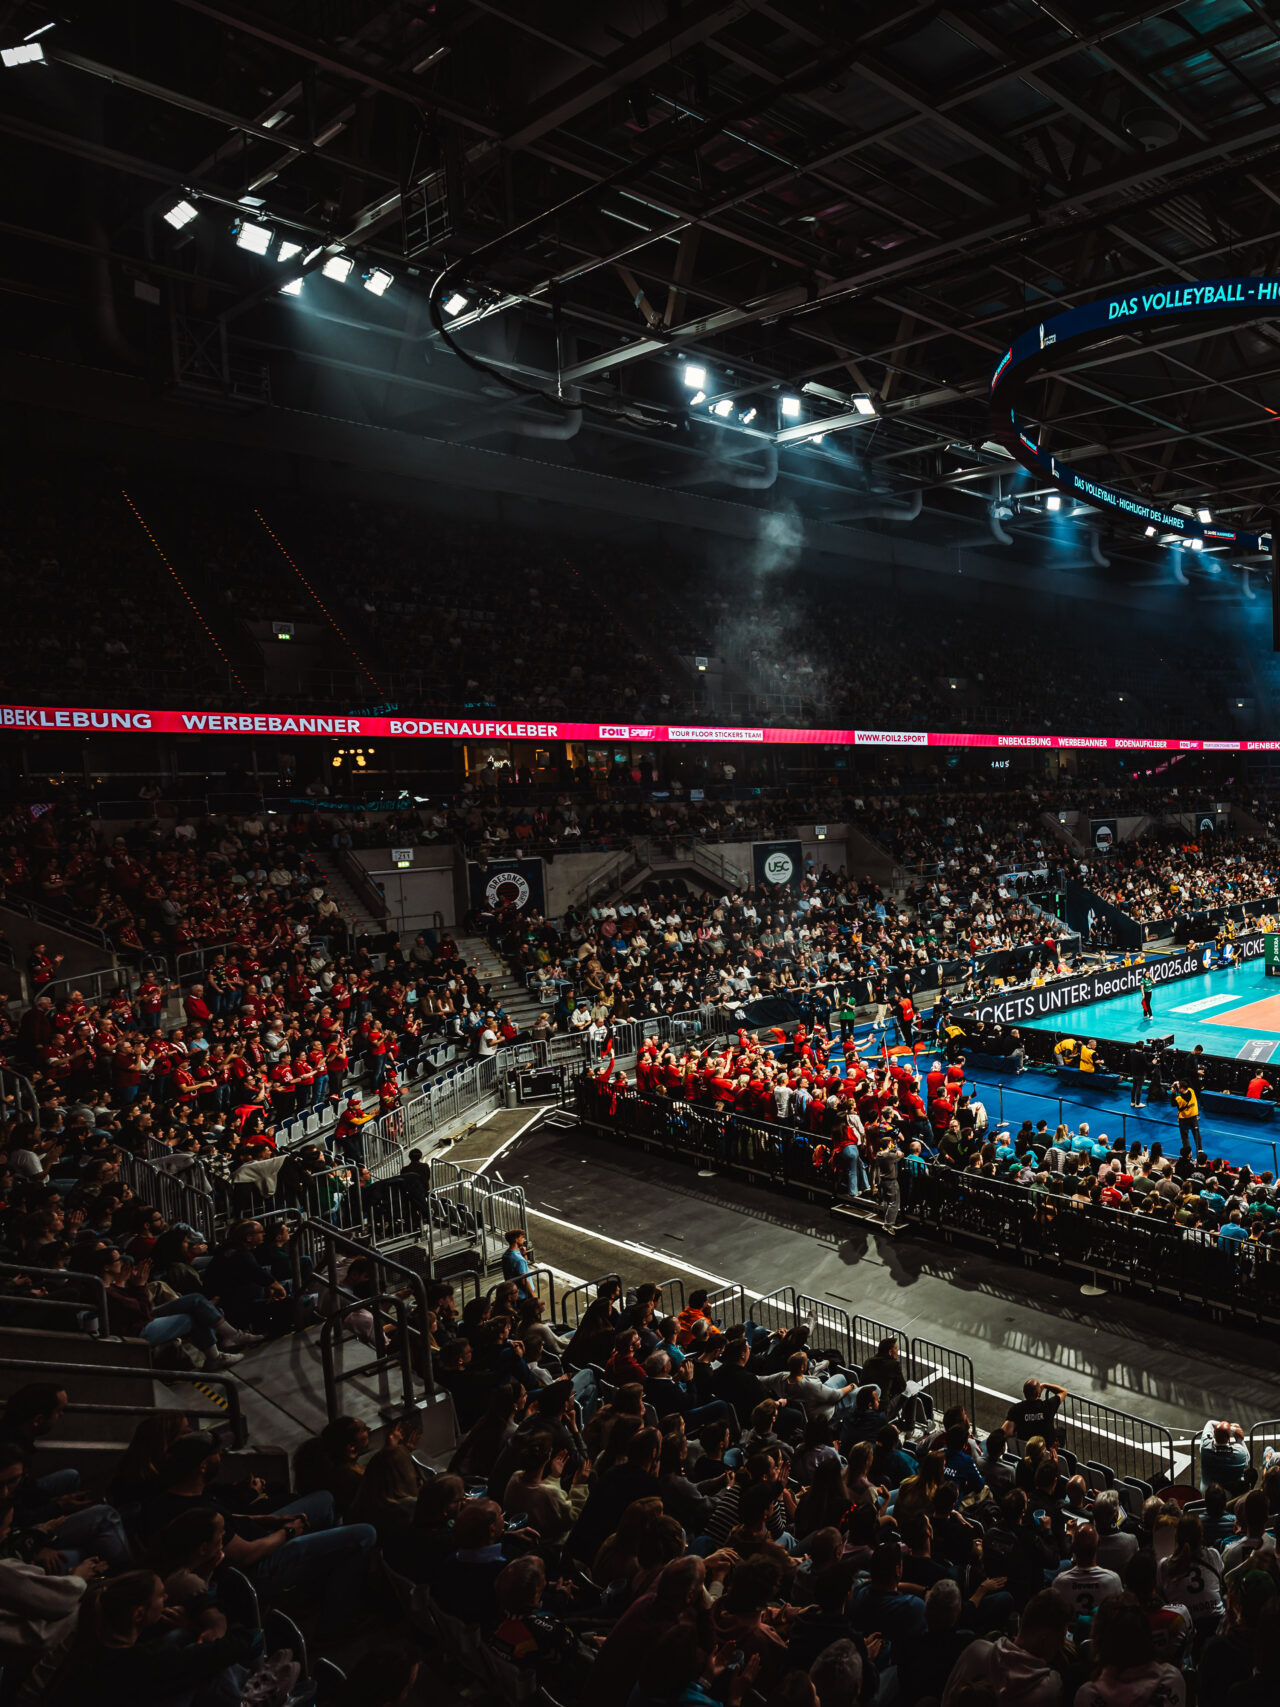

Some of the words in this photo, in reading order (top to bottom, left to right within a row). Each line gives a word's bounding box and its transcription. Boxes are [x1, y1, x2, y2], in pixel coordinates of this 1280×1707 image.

[1108, 297, 1138, 320] DAS
[1142, 283, 1245, 313] VOLLEYBALL
[1073, 475, 1085, 489] DAS
[1084, 481, 1117, 506] VOLLEYBALL
[1119, 498, 1150, 519] HIGHLIGHT
[1150, 510, 1162, 523] DES
[1162, 512, 1185, 529] JAHRES
[0, 708, 152, 729] BEKLEBUNG
[181, 714, 361, 734] WERBEBANNER
[390, 720, 558, 737] BODENAUFKLEBER
[691, 730, 713, 738] FLOOR
[857, 734, 926, 743] WWW.FOIL2.SPORT
[1058, 738, 1107, 747] WERBEBANNER
[1115, 739, 1167, 748] BODENAUFKLEBER
[768, 860, 789, 873] USC
[489, 873, 525, 890] DRESDNER
[1039, 983, 1091, 1012] UNTER:
[1094, 955, 1198, 998] beachEM2025.de
[1186, 1567, 1205, 1594] 3
